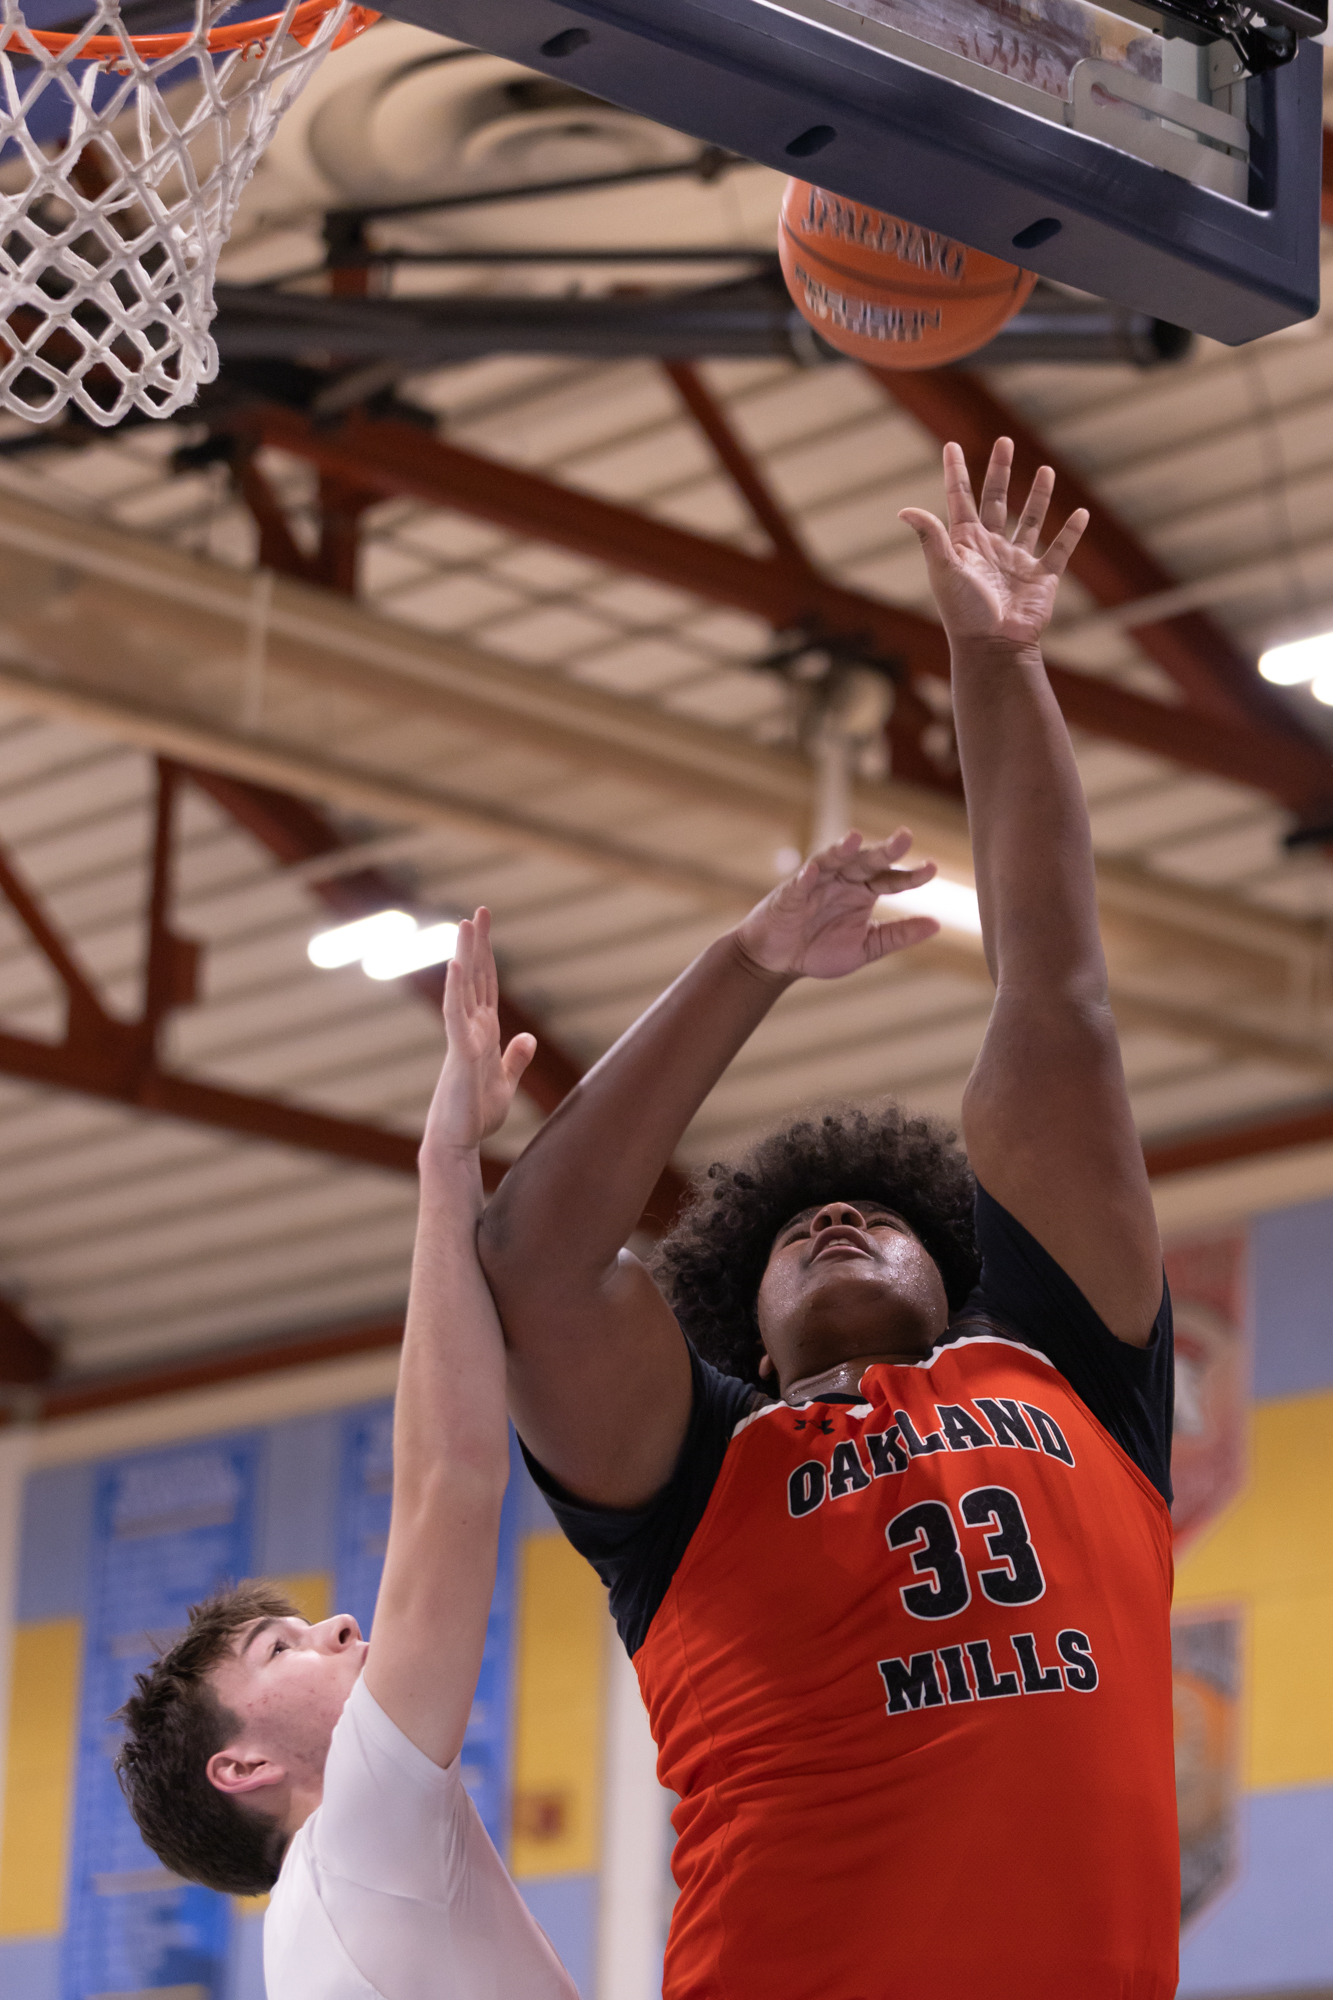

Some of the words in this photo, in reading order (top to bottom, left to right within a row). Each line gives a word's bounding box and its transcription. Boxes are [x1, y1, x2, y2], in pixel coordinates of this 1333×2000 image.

[788, 1398, 1076, 1518] OAKLAND
[885, 1485, 1046, 1621] 33
[877, 1628, 1099, 1716] MILLS
